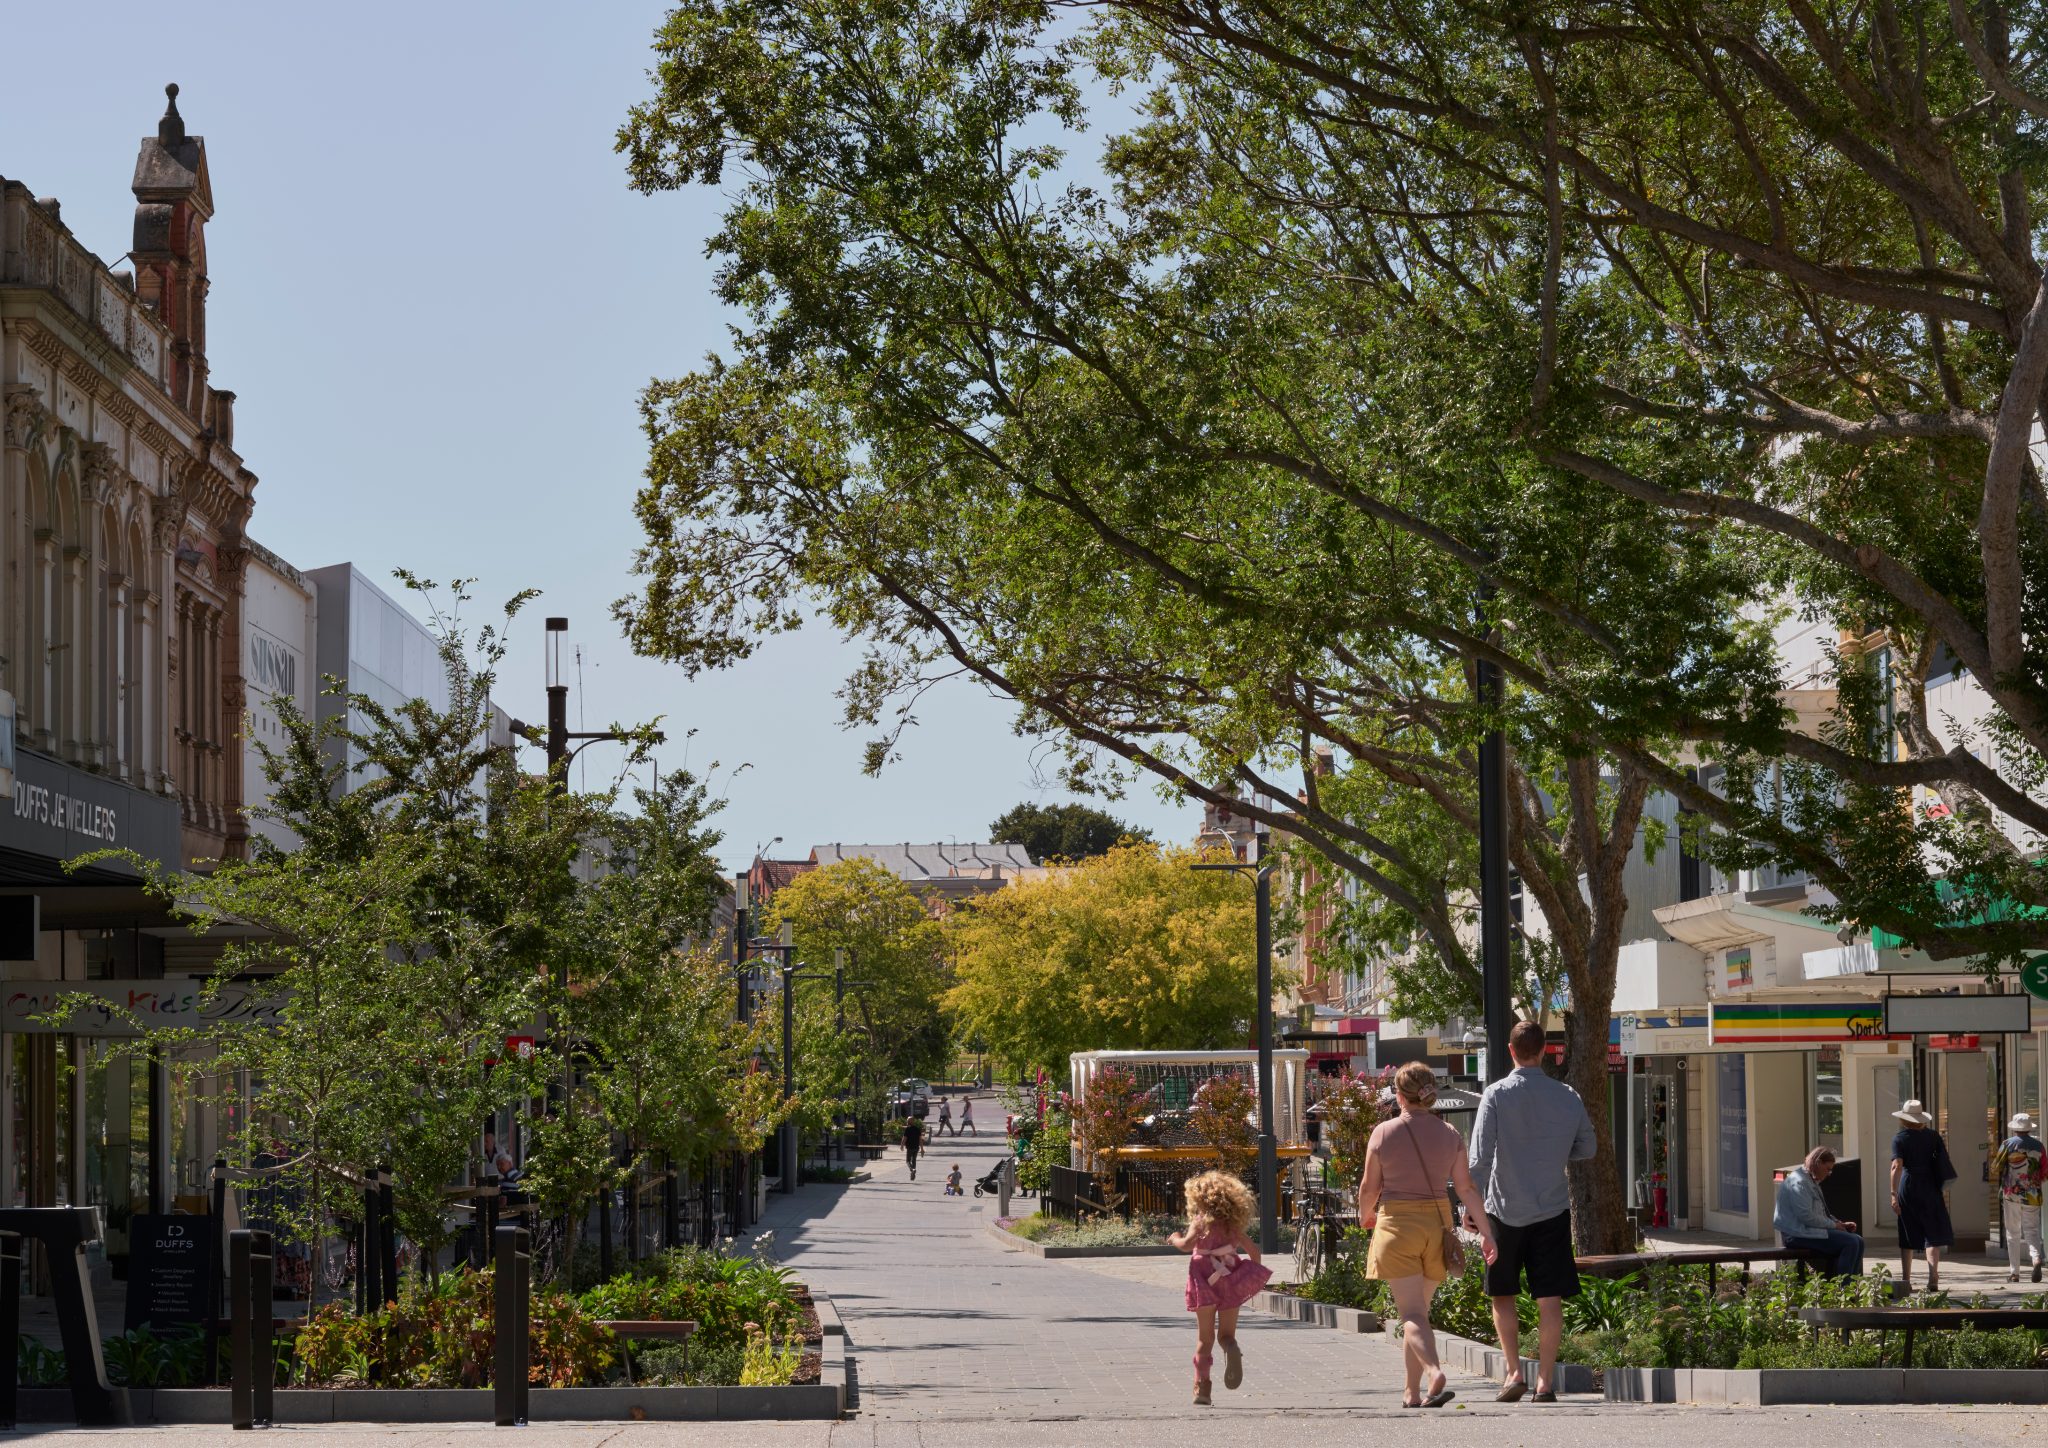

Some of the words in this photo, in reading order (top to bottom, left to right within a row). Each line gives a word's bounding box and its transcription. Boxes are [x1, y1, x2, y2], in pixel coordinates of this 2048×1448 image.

[251, 632, 295, 695] sussan
[14, 781, 49, 824] DUFFS
[50, 793, 116, 842] JEWELLERS
[128, 989, 193, 1014] Kids
[1622, 1016, 1634, 1027] 2P
[1846, 1013, 1886, 1041] Sports
[155, 1239, 194, 1249] DUFFS
